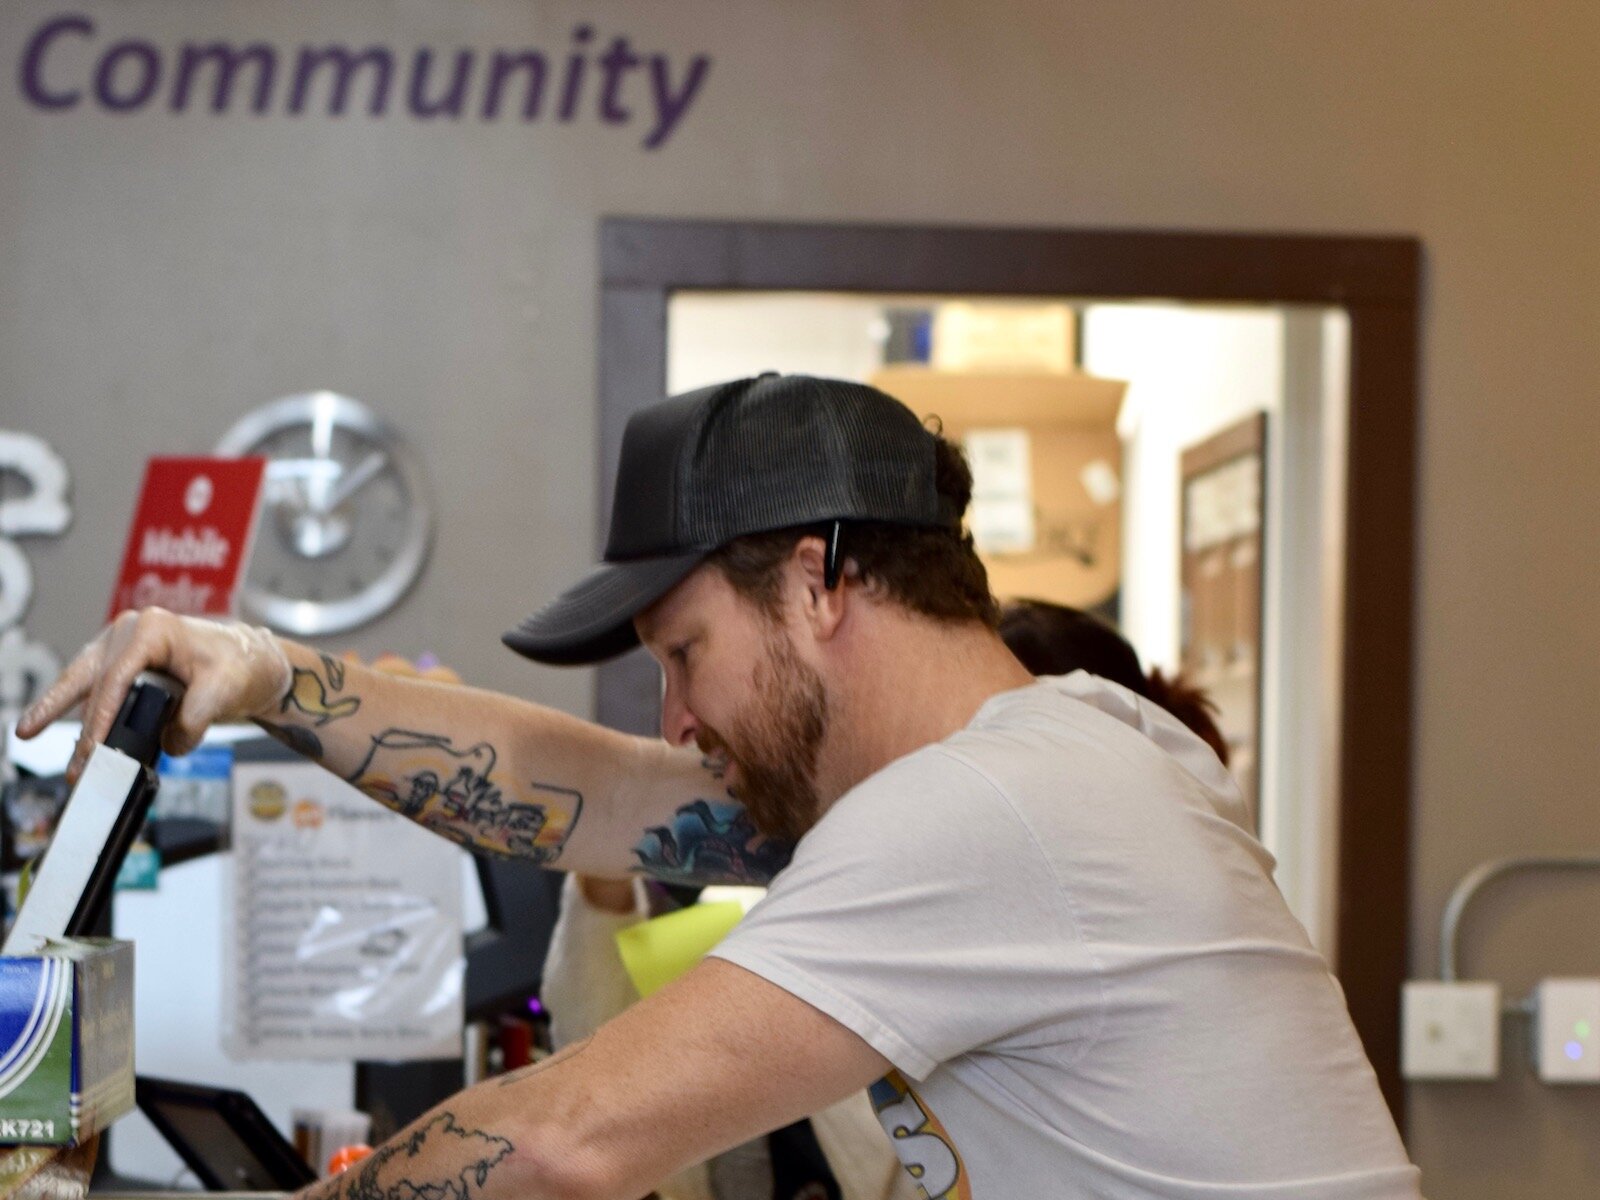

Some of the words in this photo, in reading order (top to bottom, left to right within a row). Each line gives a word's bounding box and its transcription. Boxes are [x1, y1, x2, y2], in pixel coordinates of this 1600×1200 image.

[18, 15, 711, 150] Community
[138, 527, 230, 568] Mobile
[0, 1119, 54, 1138] K721
